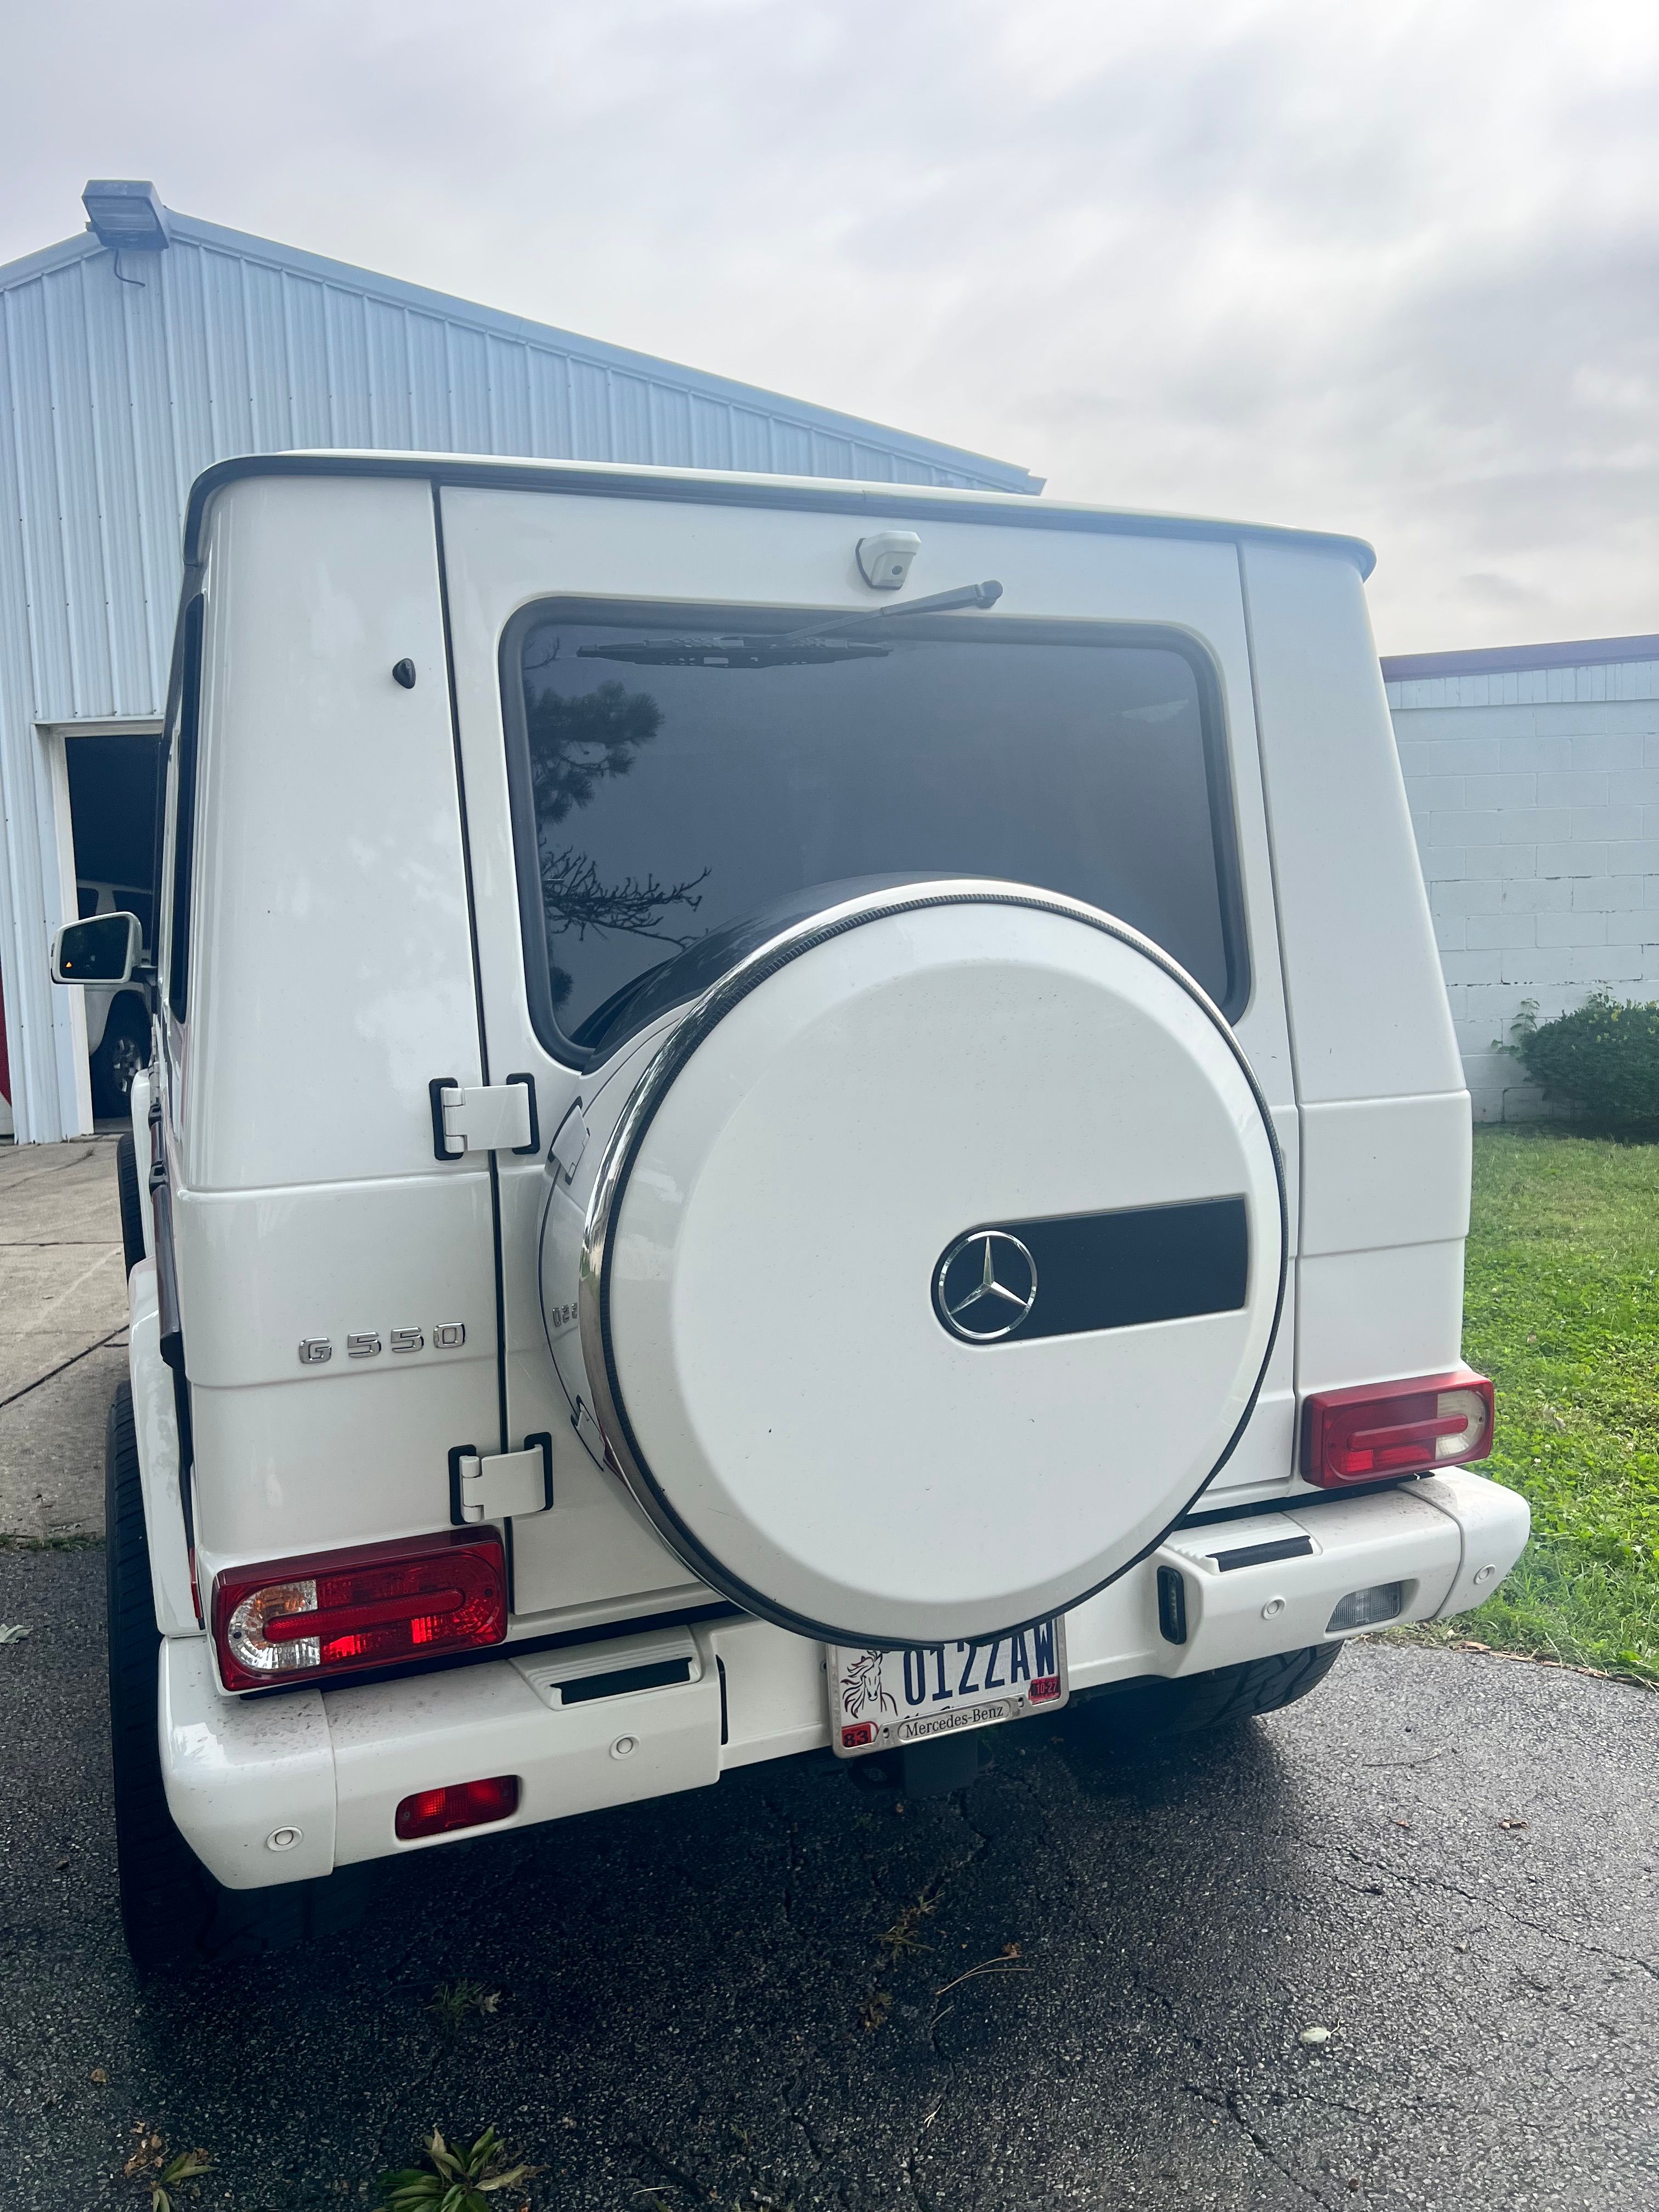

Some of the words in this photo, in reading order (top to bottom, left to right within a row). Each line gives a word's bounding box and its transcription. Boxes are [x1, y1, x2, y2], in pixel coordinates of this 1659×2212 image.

[1036, 1681, 1057, 1694] 10-27
[906, 1706, 1003, 1738] Mercedes-Benz
[844, 1730, 868, 1747] 83
